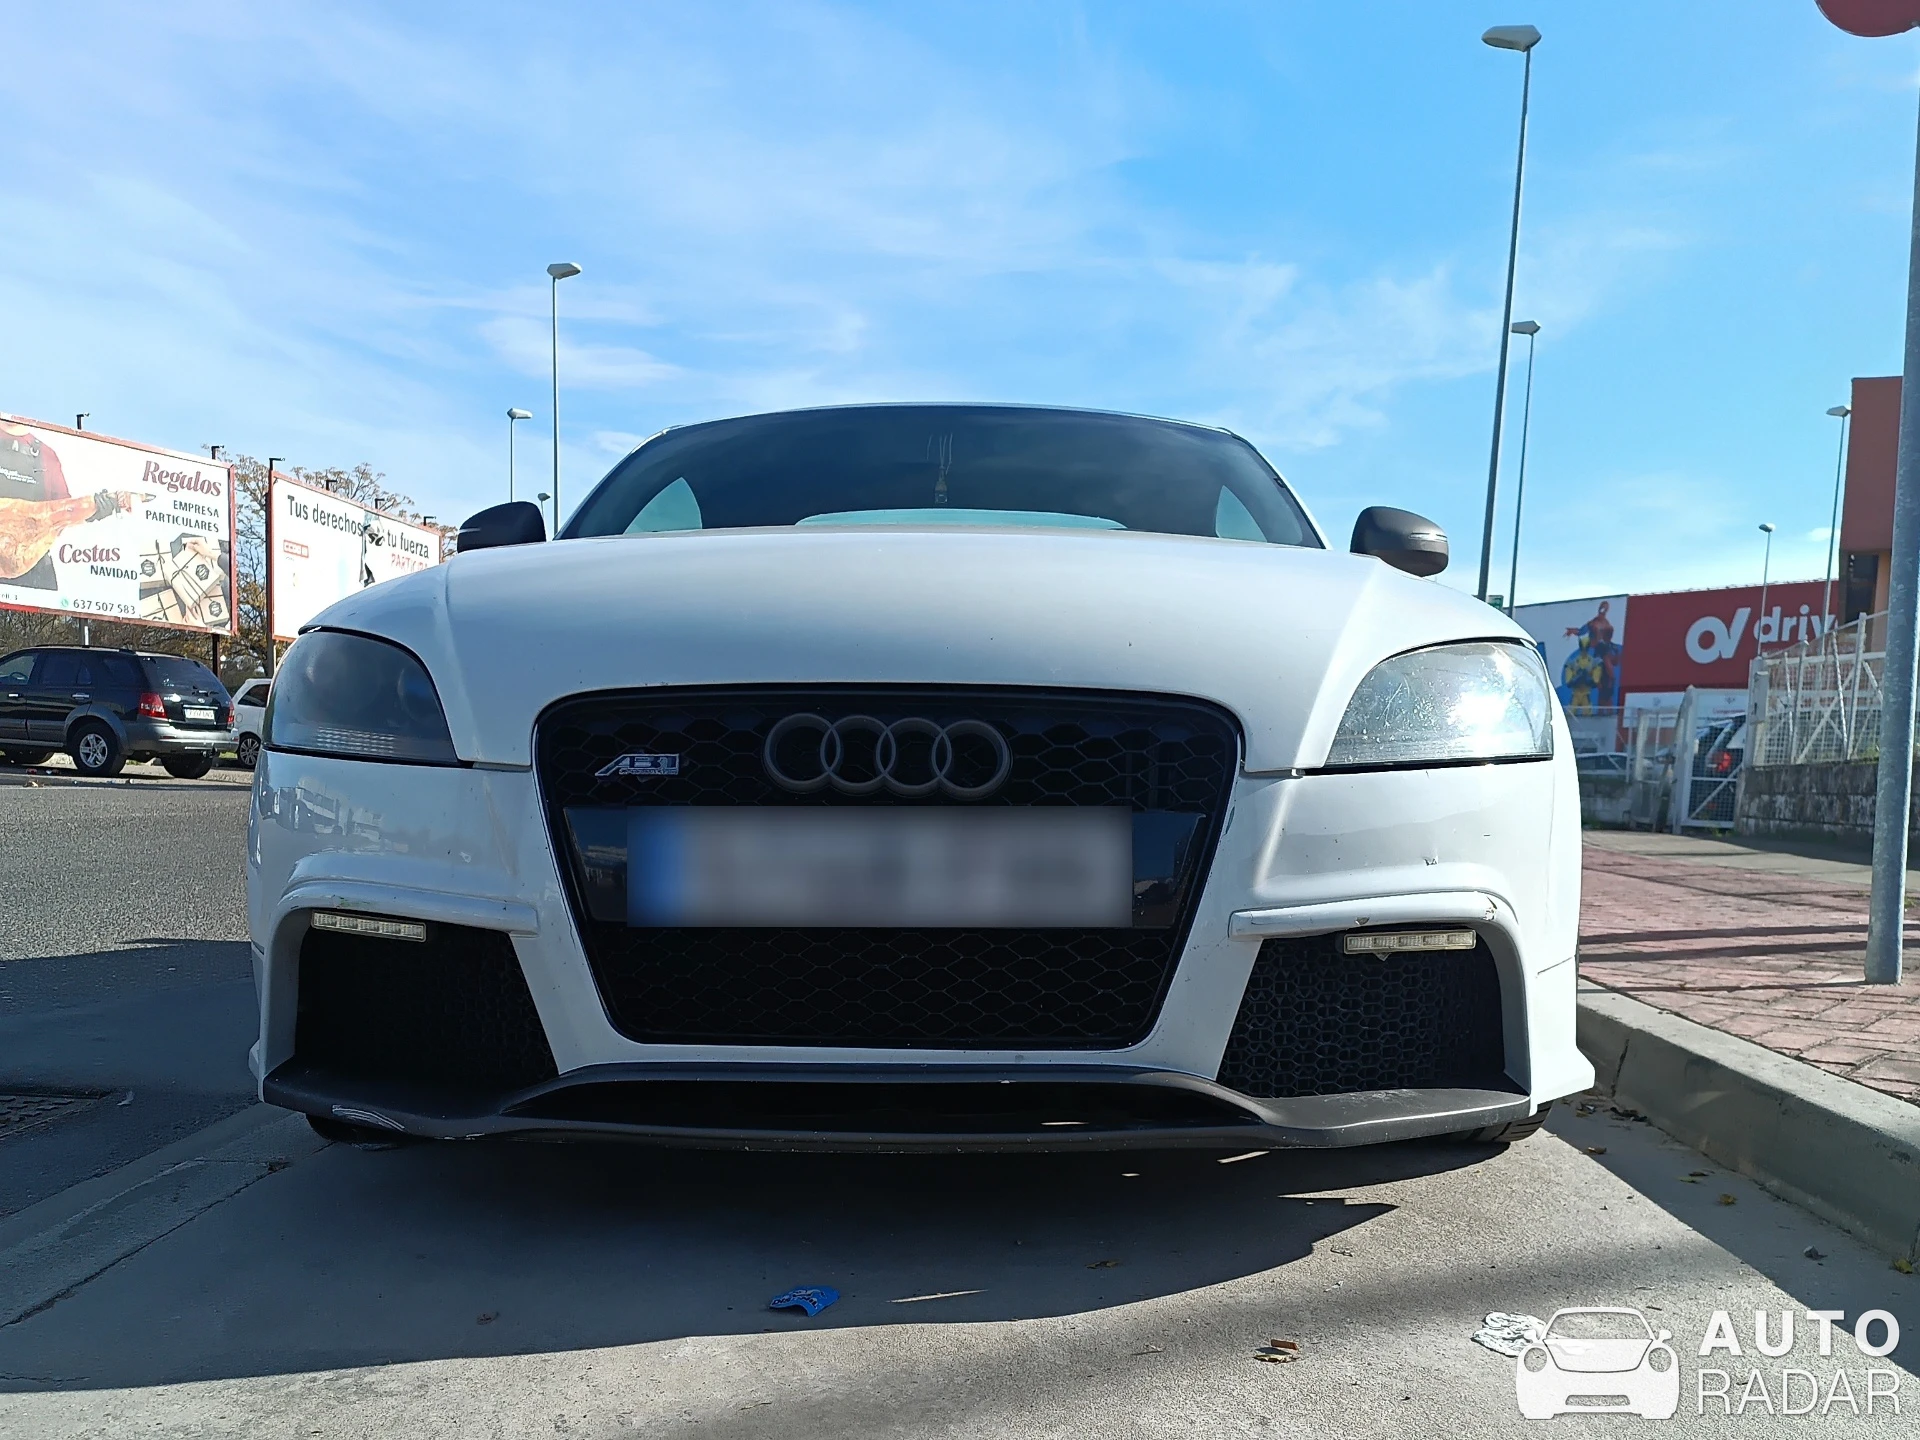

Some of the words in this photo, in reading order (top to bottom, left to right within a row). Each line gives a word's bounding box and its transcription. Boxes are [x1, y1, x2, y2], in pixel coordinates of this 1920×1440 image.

[173, 499, 220, 518] EMPRESA
[145, 509, 220, 533] PARTICULARES
[287, 494, 309, 521] Tus
[312, 502, 364, 537] derechos
[387, 529, 397, 548] tu
[400, 532, 430, 559] fuerza
[58, 543, 121, 564] Cestas
[90, 564, 138, 581] NAVIDAD
[73, 598, 92, 610] 637
[95, 600, 114, 613] 507
[117, 603, 136, 615] 583
[1753, 604, 1839, 643] driv
